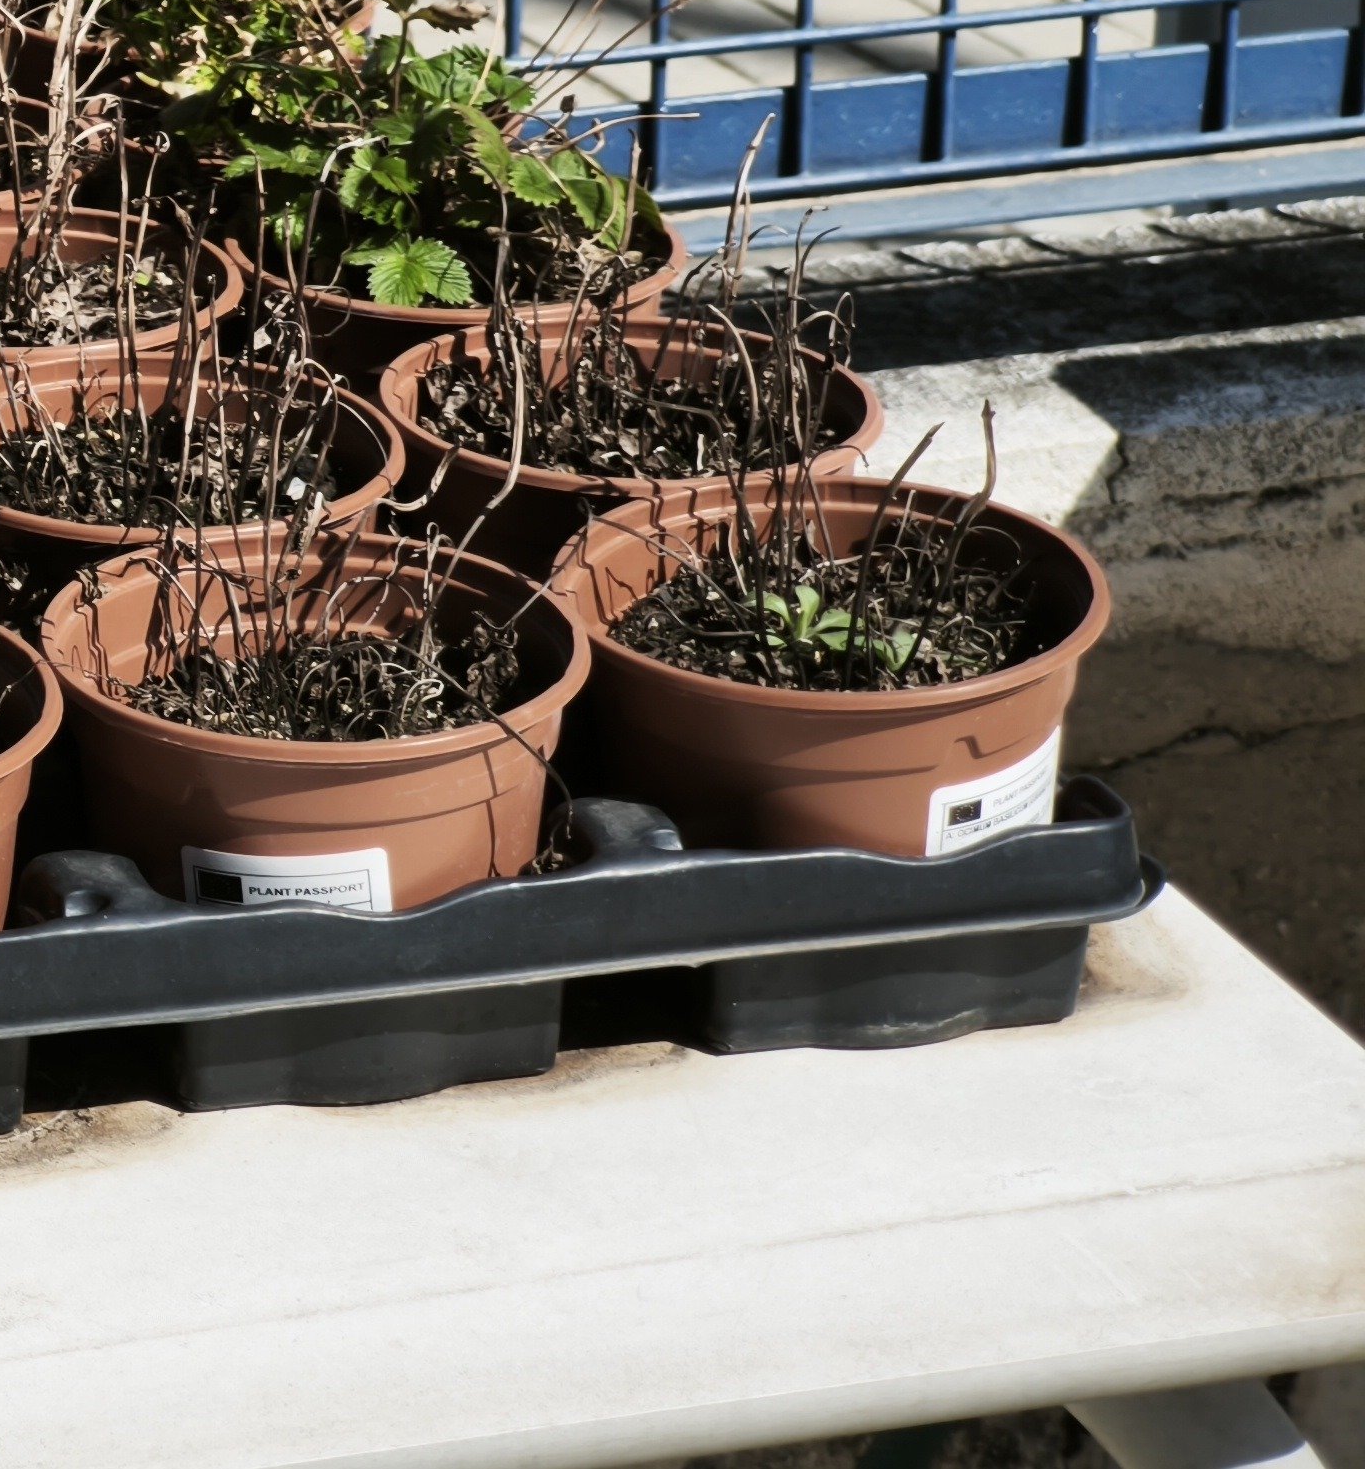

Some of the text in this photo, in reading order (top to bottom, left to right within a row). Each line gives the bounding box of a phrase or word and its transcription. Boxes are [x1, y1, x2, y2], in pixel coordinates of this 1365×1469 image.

[993, 792, 1017, 807] PLANT
[248, 882, 365, 897] PLANT PASSPORT
